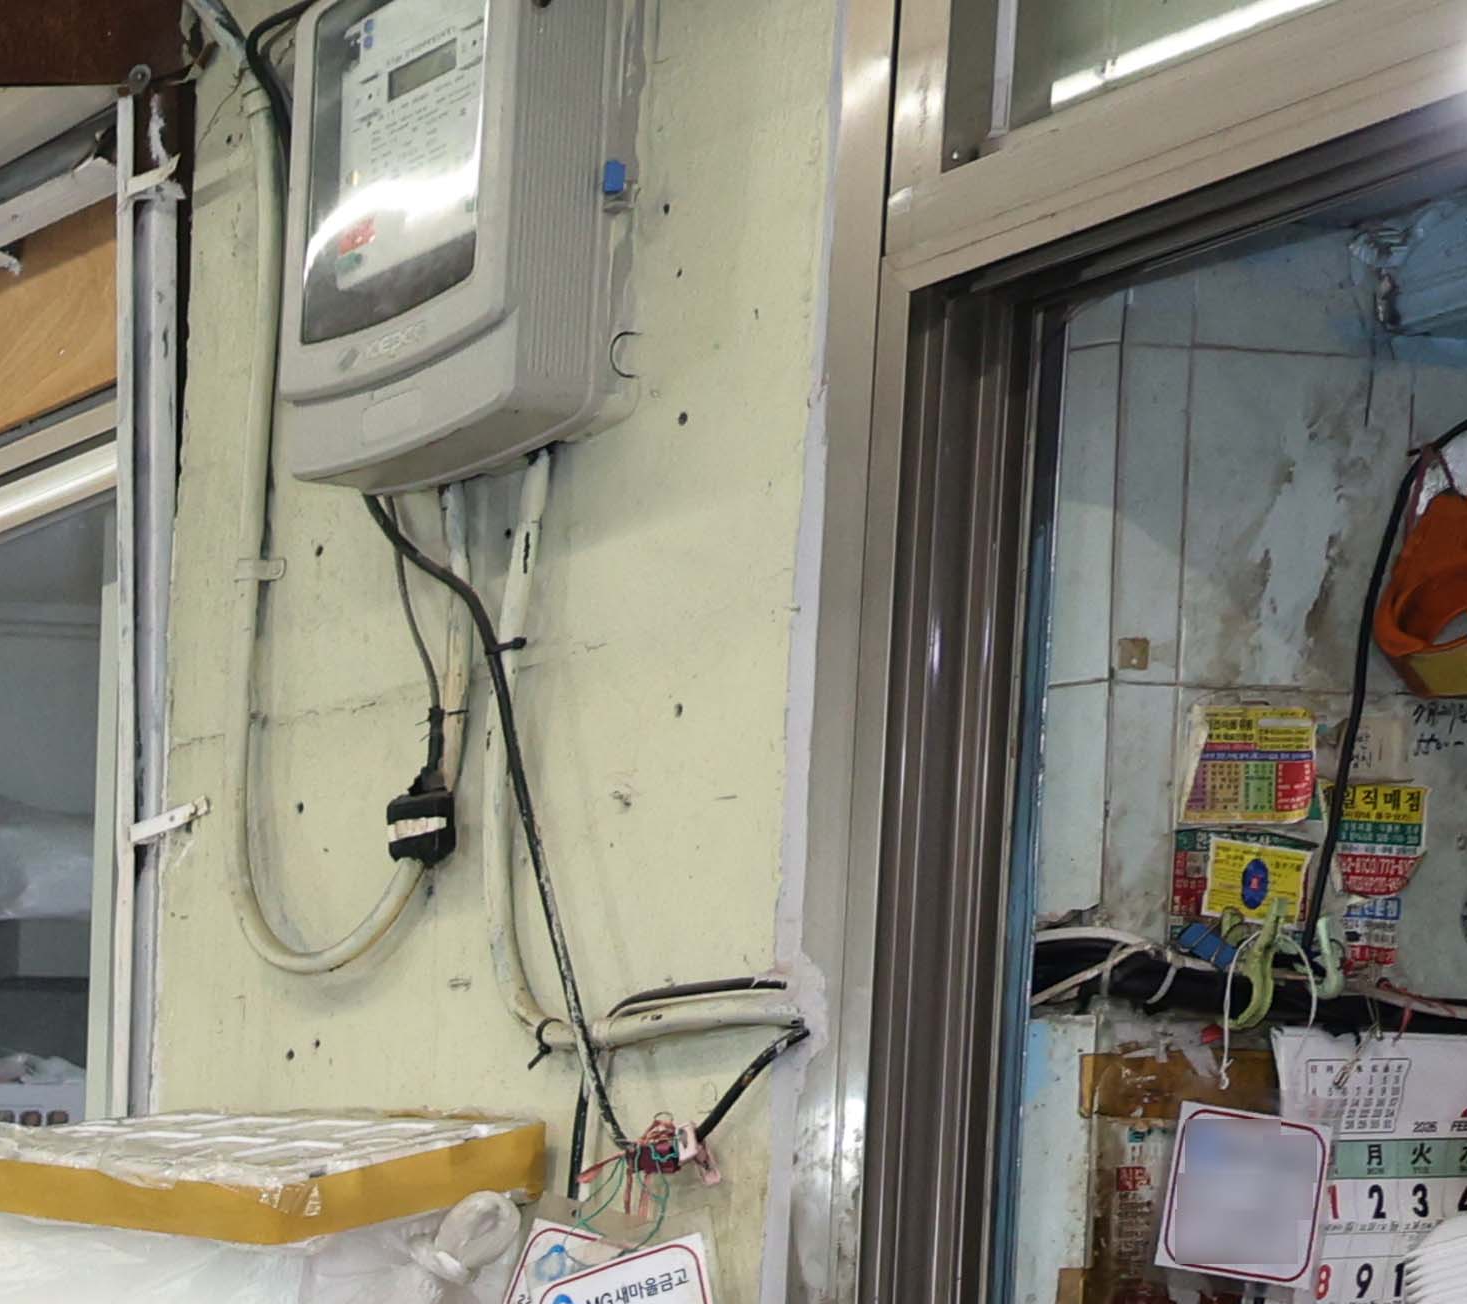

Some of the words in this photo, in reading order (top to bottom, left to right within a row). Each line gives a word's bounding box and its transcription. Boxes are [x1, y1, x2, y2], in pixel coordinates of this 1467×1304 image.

[1367, 1143, 1383, 1166] 月
[1410, 1142, 1432, 1165] 火
[1327, 1184, 1339, 1220] 1
[1367, 1184, 1387, 1220] 2
[1411, 1183, 1429, 1218] 3
[1316, 1264, 1331, 1300] 8
[1356, 1263, 1373, 1299] 9
[1394, 1262, 1407, 1298] 1
